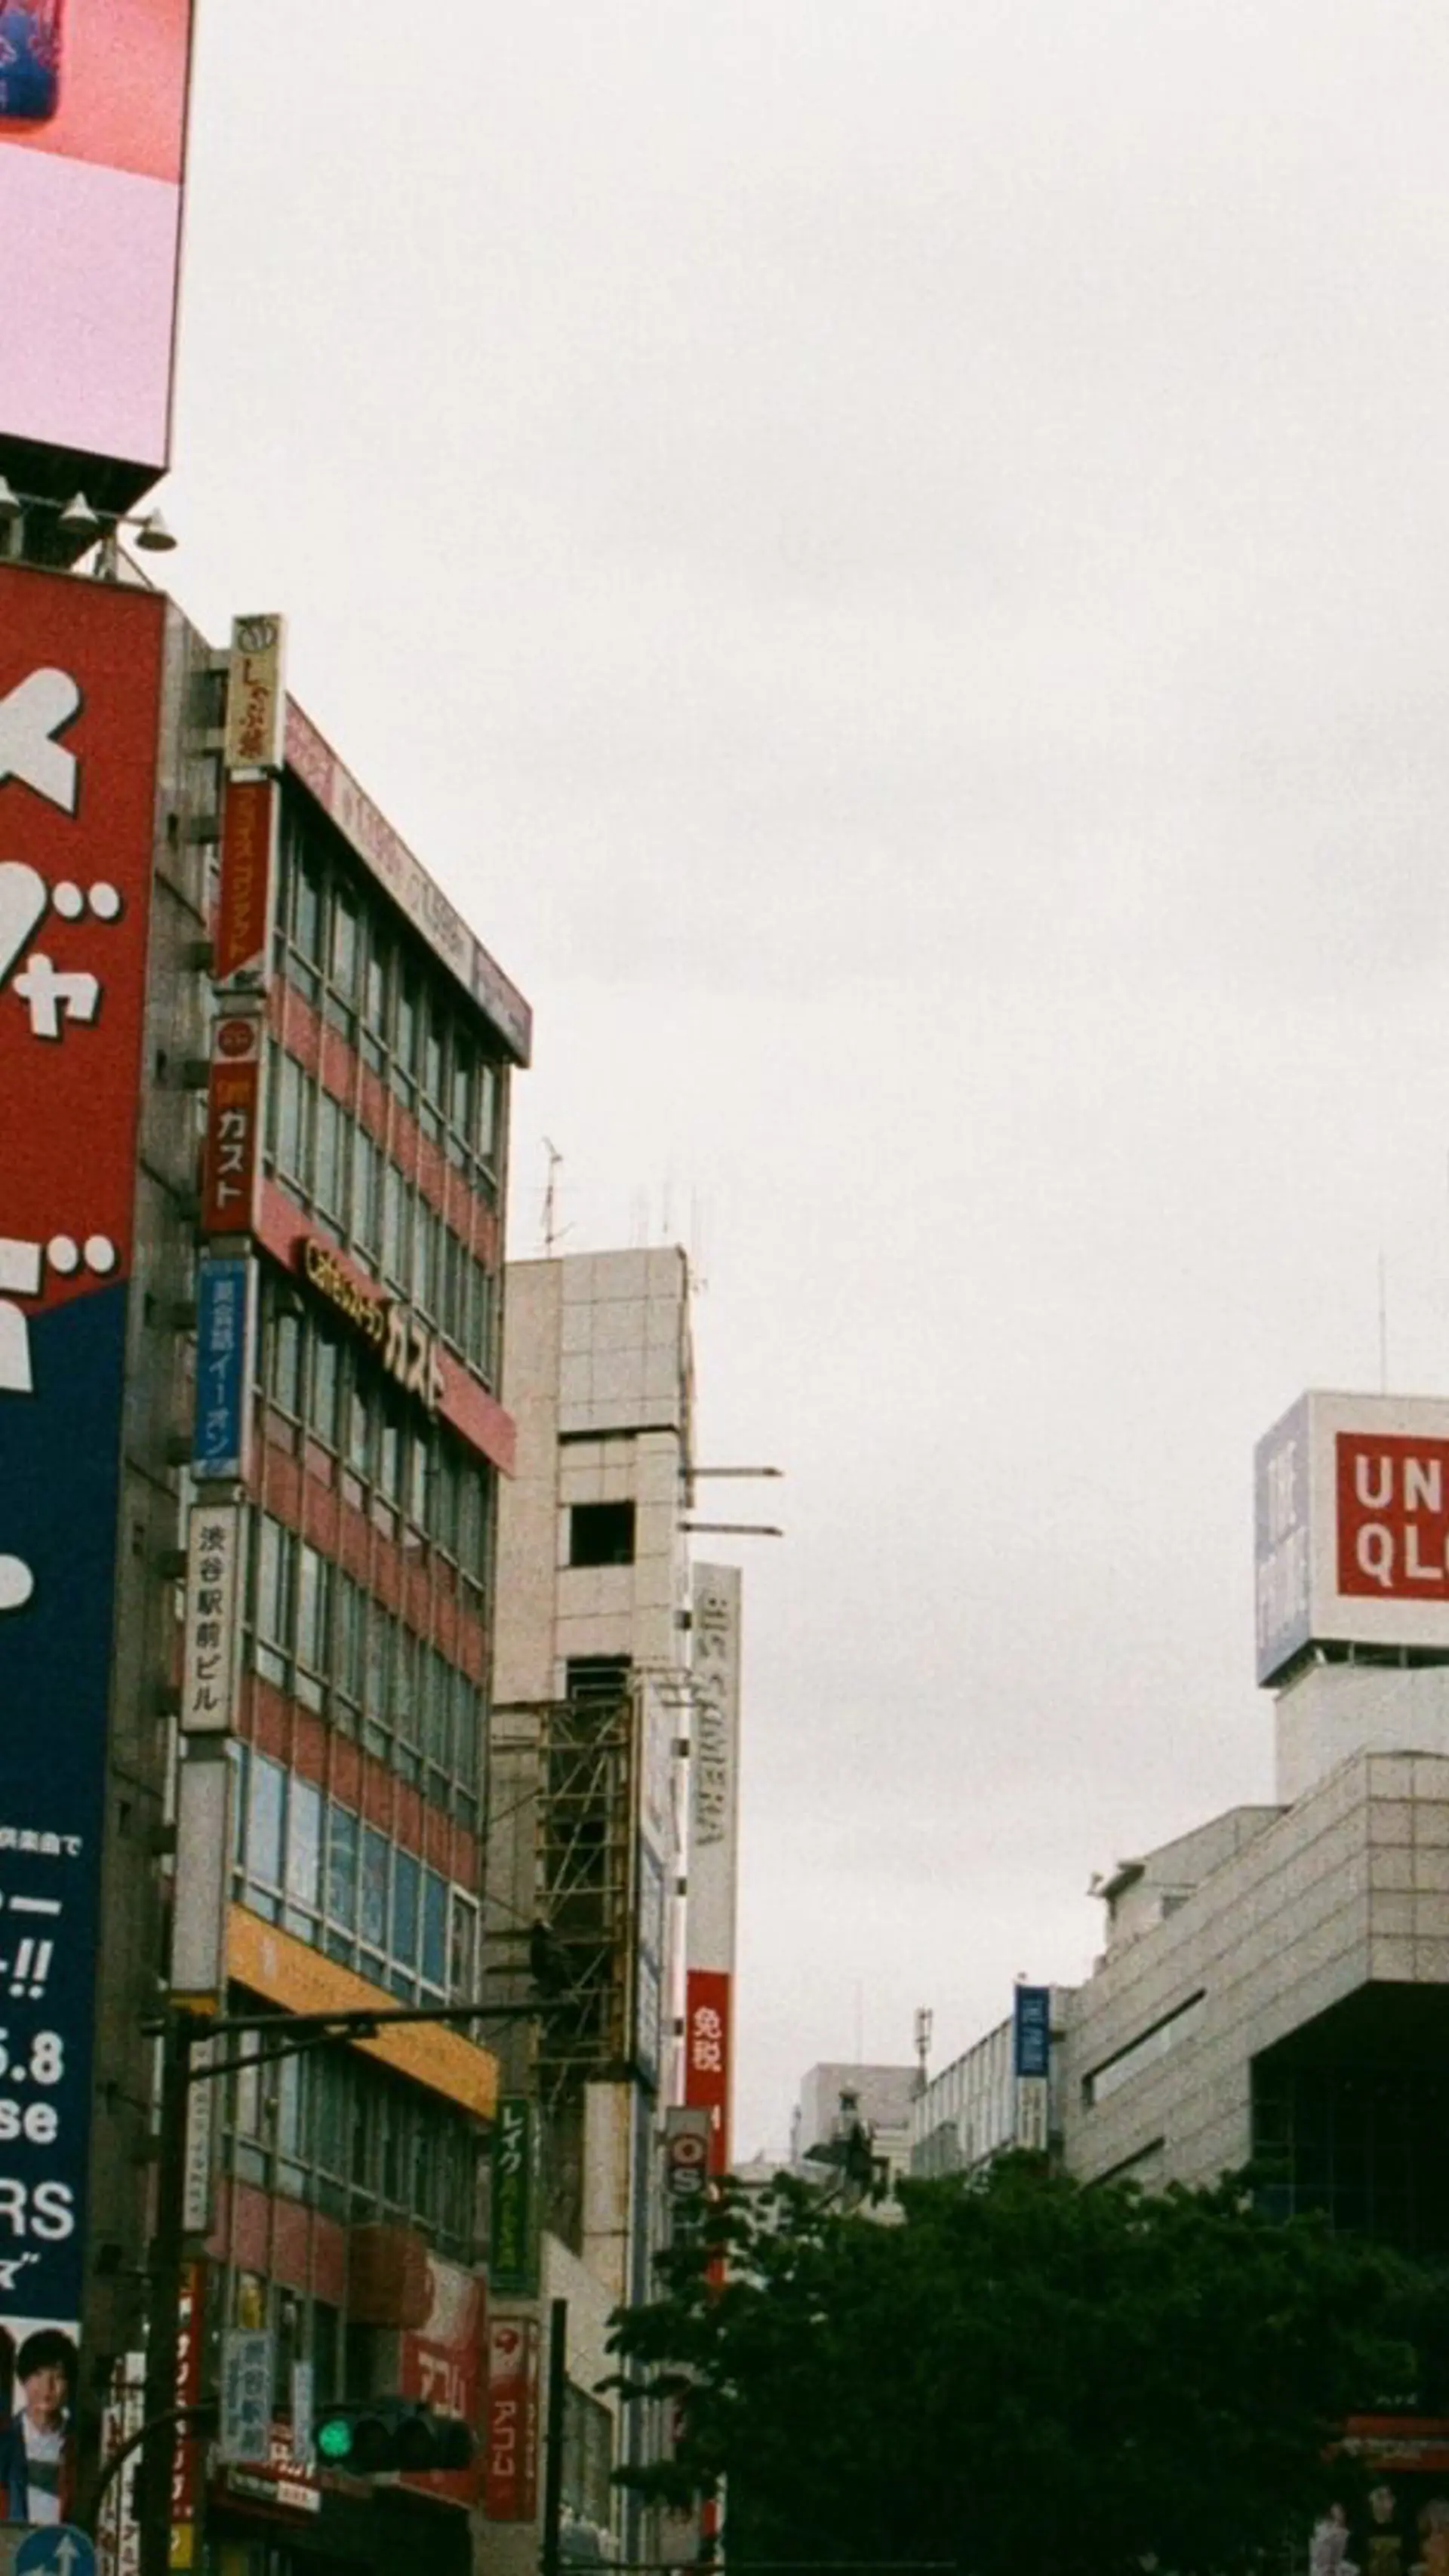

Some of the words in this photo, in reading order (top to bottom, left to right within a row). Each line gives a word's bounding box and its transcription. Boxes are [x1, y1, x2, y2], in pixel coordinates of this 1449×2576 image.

[217, 1106, 246, 1208] ガスト
[1356, 1522, 1449, 1589] QL
[193, 1526, 226, 1713] 渋谷駅前ビル
[0, 2027, 64, 2085] .8
[499, 2106, 524, 2175] レイク
